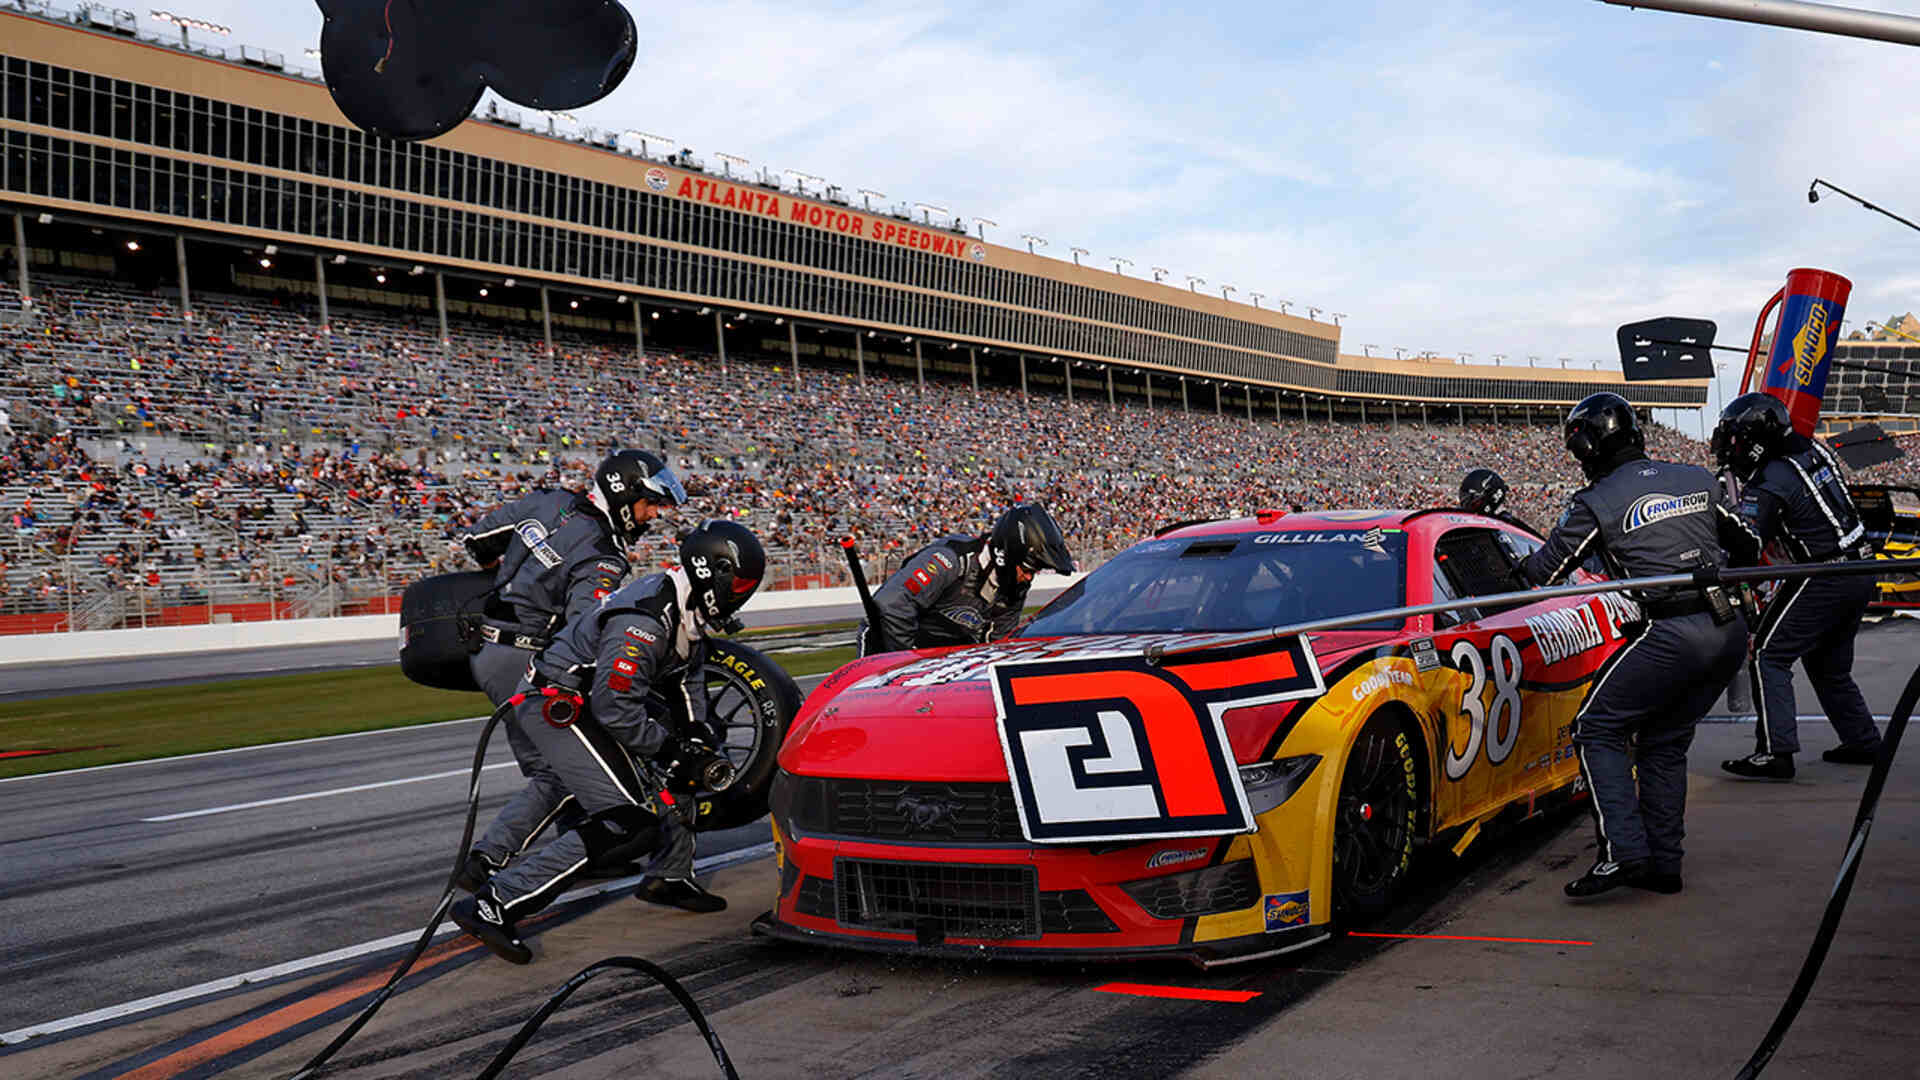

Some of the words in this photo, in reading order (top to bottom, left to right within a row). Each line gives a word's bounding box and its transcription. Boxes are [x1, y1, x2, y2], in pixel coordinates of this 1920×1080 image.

[678, 176, 780, 218] ATLANTA
[790, 201, 863, 237] MOTOR
[871, 221, 967, 258] SPEEDWAY
[1798, 305, 1826, 385] SUNOCO
[1749, 444, 1764, 462] 38
[606, 472, 625, 493] 38
[691, 556, 712, 579] 38
[626, 626, 657, 642] FORD
[1352, 665, 1414, 702] GOODYEAR
[1446, 634, 1523, 782] 38
